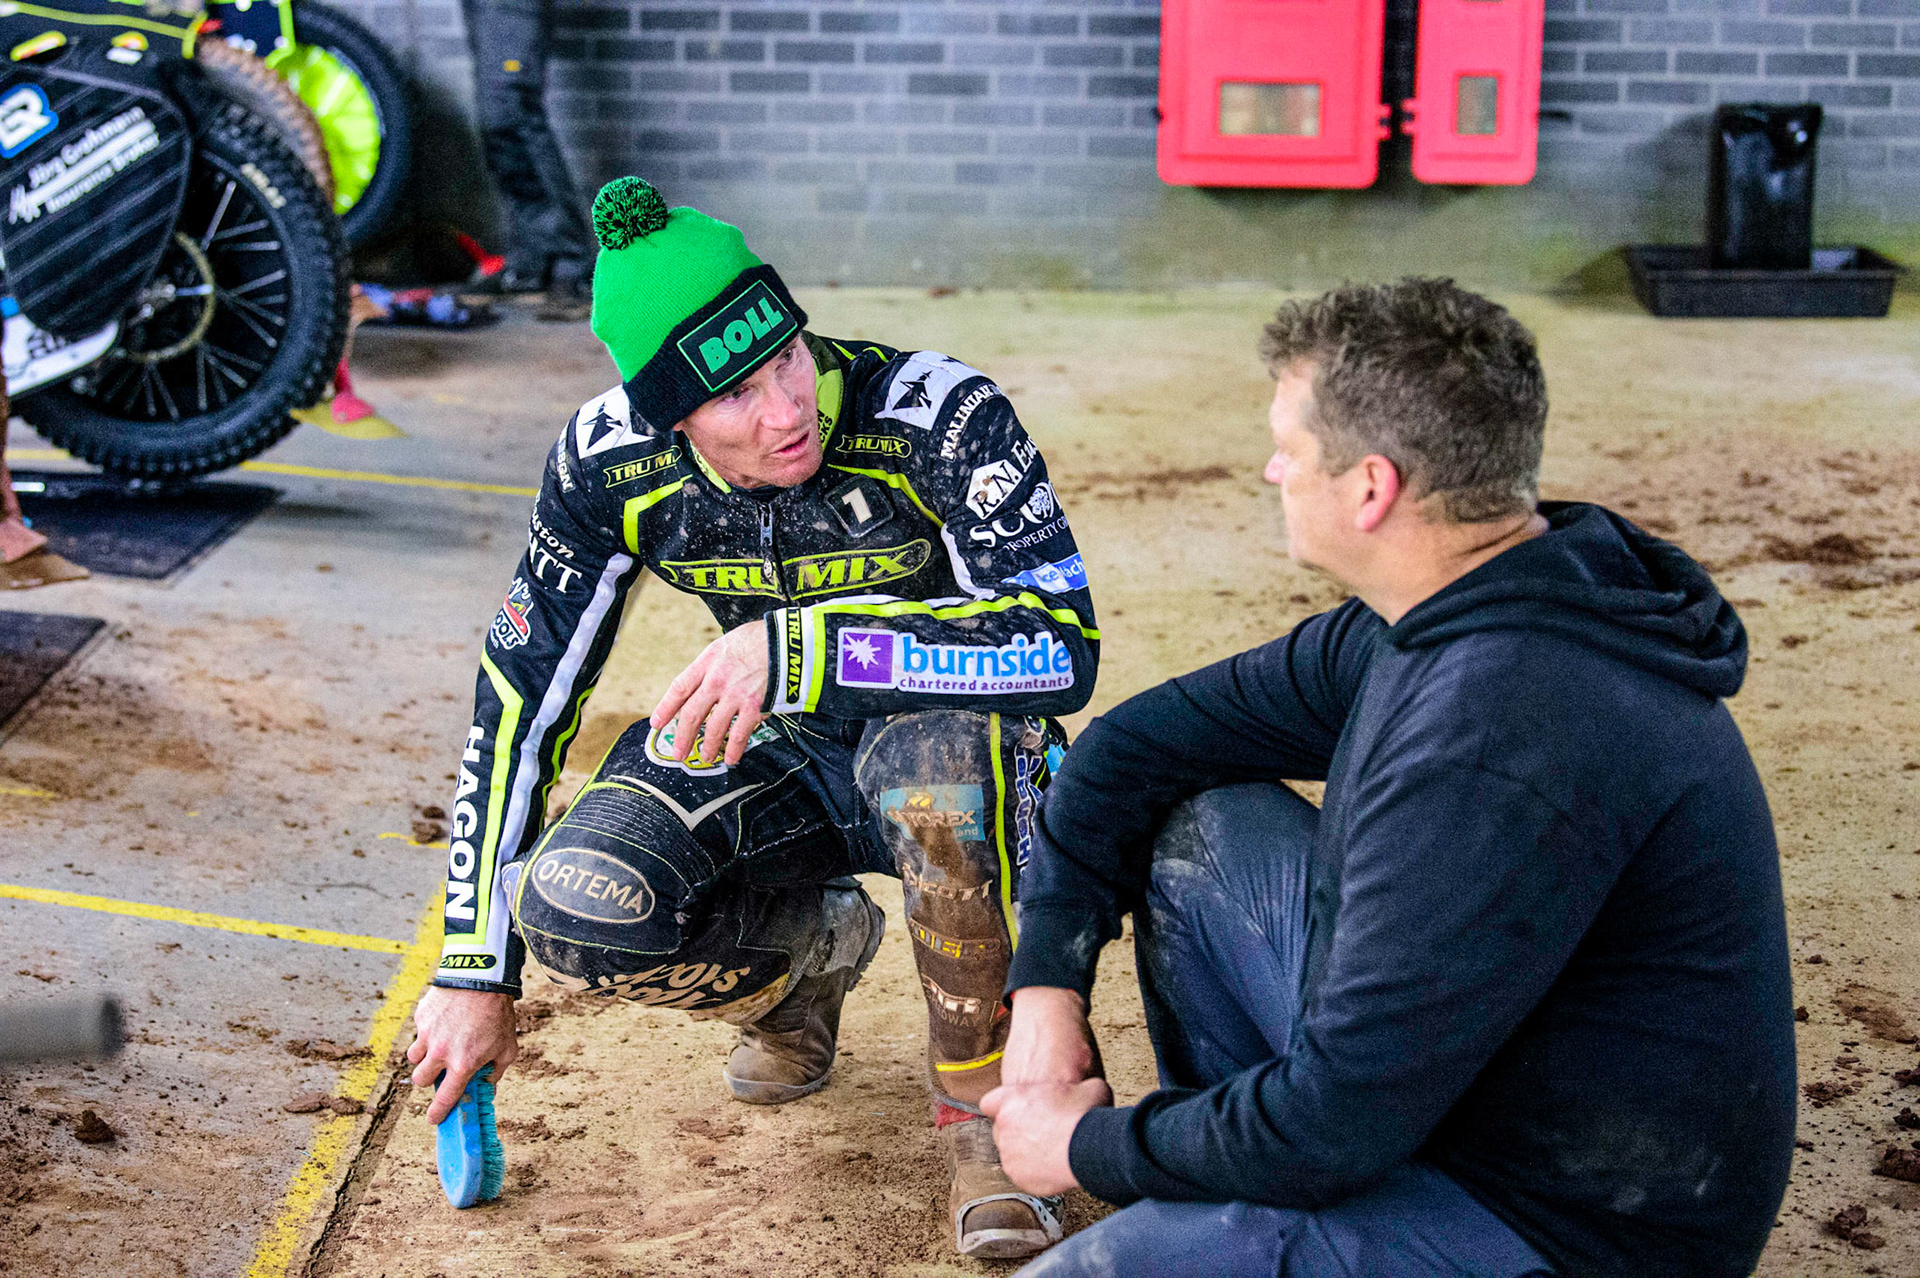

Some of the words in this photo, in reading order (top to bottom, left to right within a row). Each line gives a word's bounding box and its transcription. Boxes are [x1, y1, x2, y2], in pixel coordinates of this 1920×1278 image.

[698, 297, 784, 374] BOLL
[847, 437, 880, 450] TRU
[611, 459, 651, 481] TRU
[841, 487, 873, 525] 1
[683, 566, 778, 592] TRU
[796, 550, 909, 591] MIX
[788, 609, 802, 651] TRU
[788, 651, 802, 698] MIX
[902, 635, 1070, 678] burnside
[900, 676, 978, 692] chartered
[980, 676, 1070, 692] accountants
[444, 725, 486, 921] HAGON
[538, 859, 643, 915] ORTEMA
[447, 955, 490, 968] MIX
